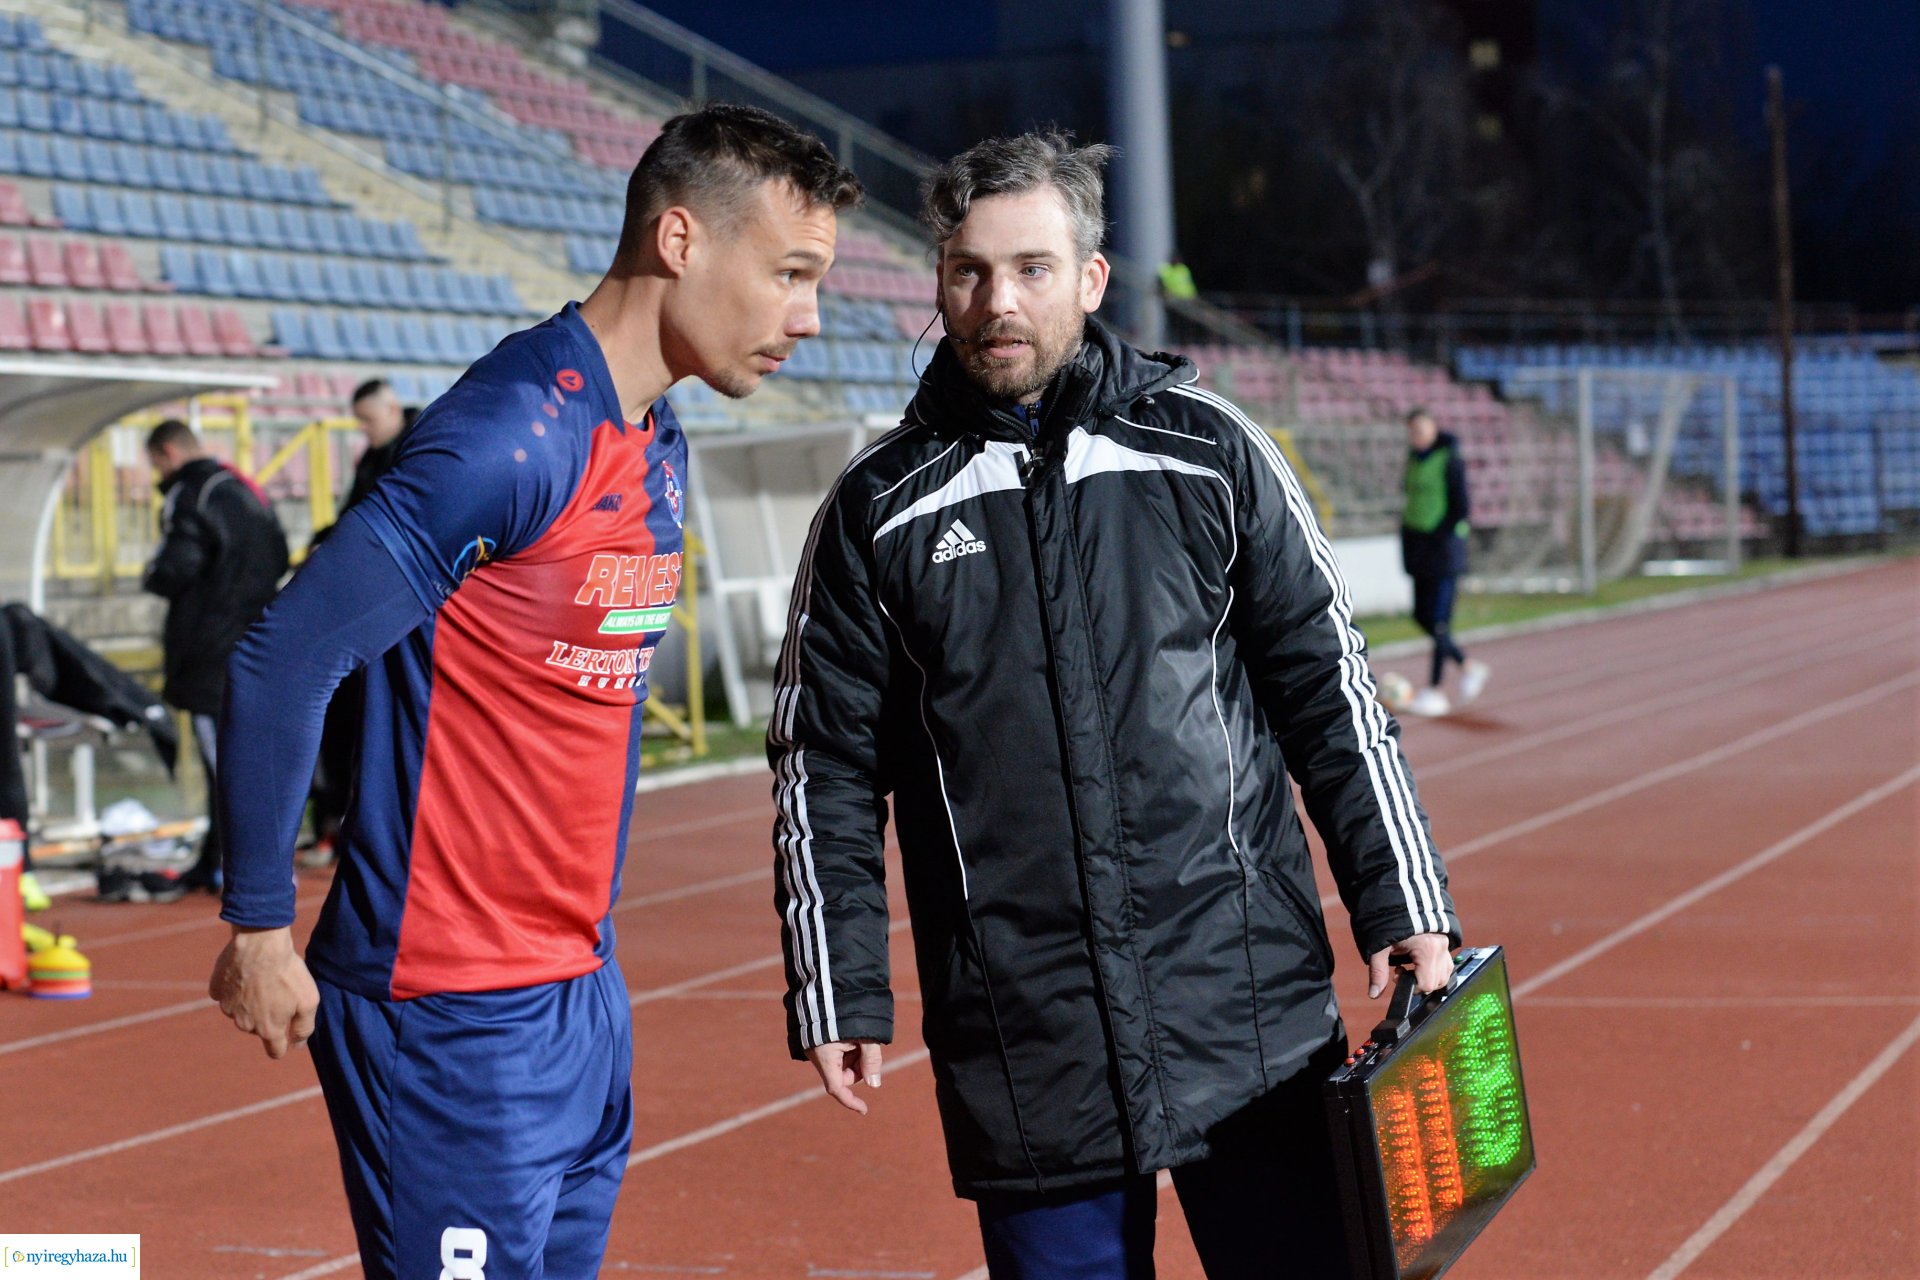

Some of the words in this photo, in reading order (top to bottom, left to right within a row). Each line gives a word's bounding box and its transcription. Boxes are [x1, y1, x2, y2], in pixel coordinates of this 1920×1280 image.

[932, 540, 986, 563] adidas
[604, 616, 635, 628] ALWAYS
[644, 614, 656, 625] THE
[545, 640, 640, 675] LERTON
[439, 1226, 487, 1280] 8
